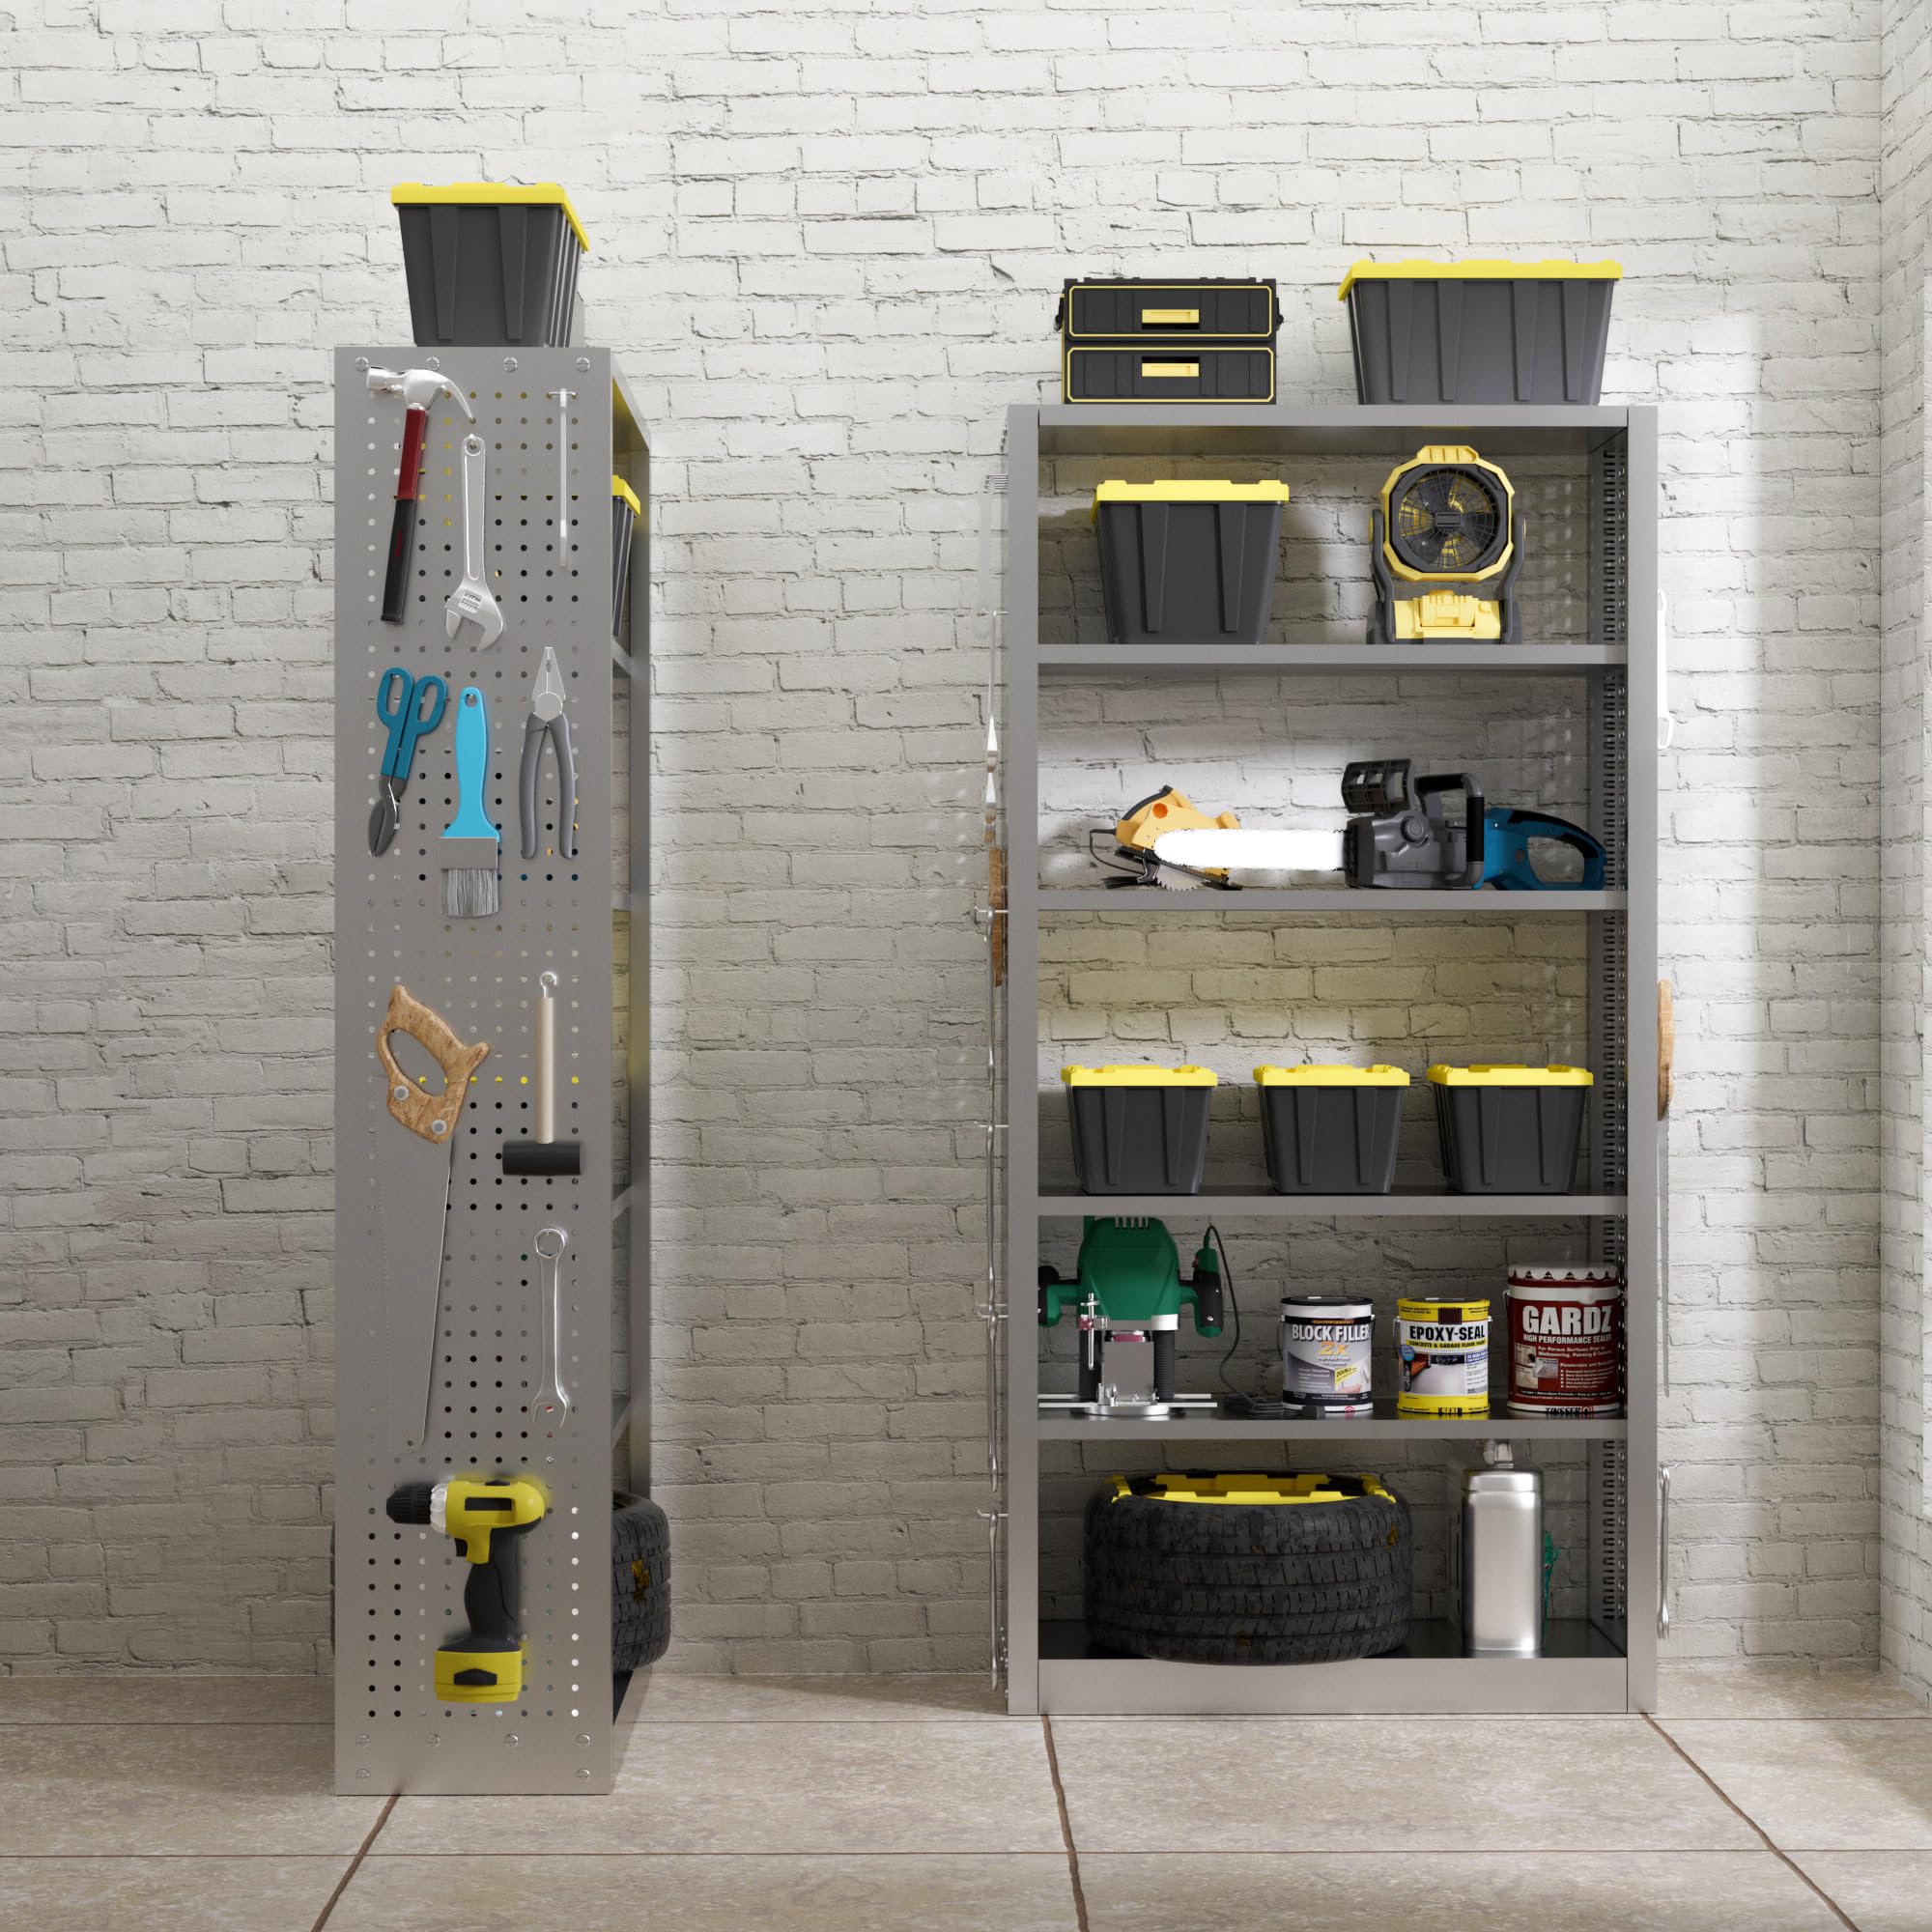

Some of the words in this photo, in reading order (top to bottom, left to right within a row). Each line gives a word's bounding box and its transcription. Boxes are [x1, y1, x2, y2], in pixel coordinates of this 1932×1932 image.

[1522, 1305, 1612, 1335] GARDZ
[1293, 1324, 1332, 1341] BLOCK
[1335, 1324, 1370, 1342] FILLER
[1409, 1325, 1485, 1341] EPOXY-SEAL
[1538, 1335, 1592, 1344] PERFORMANCE
